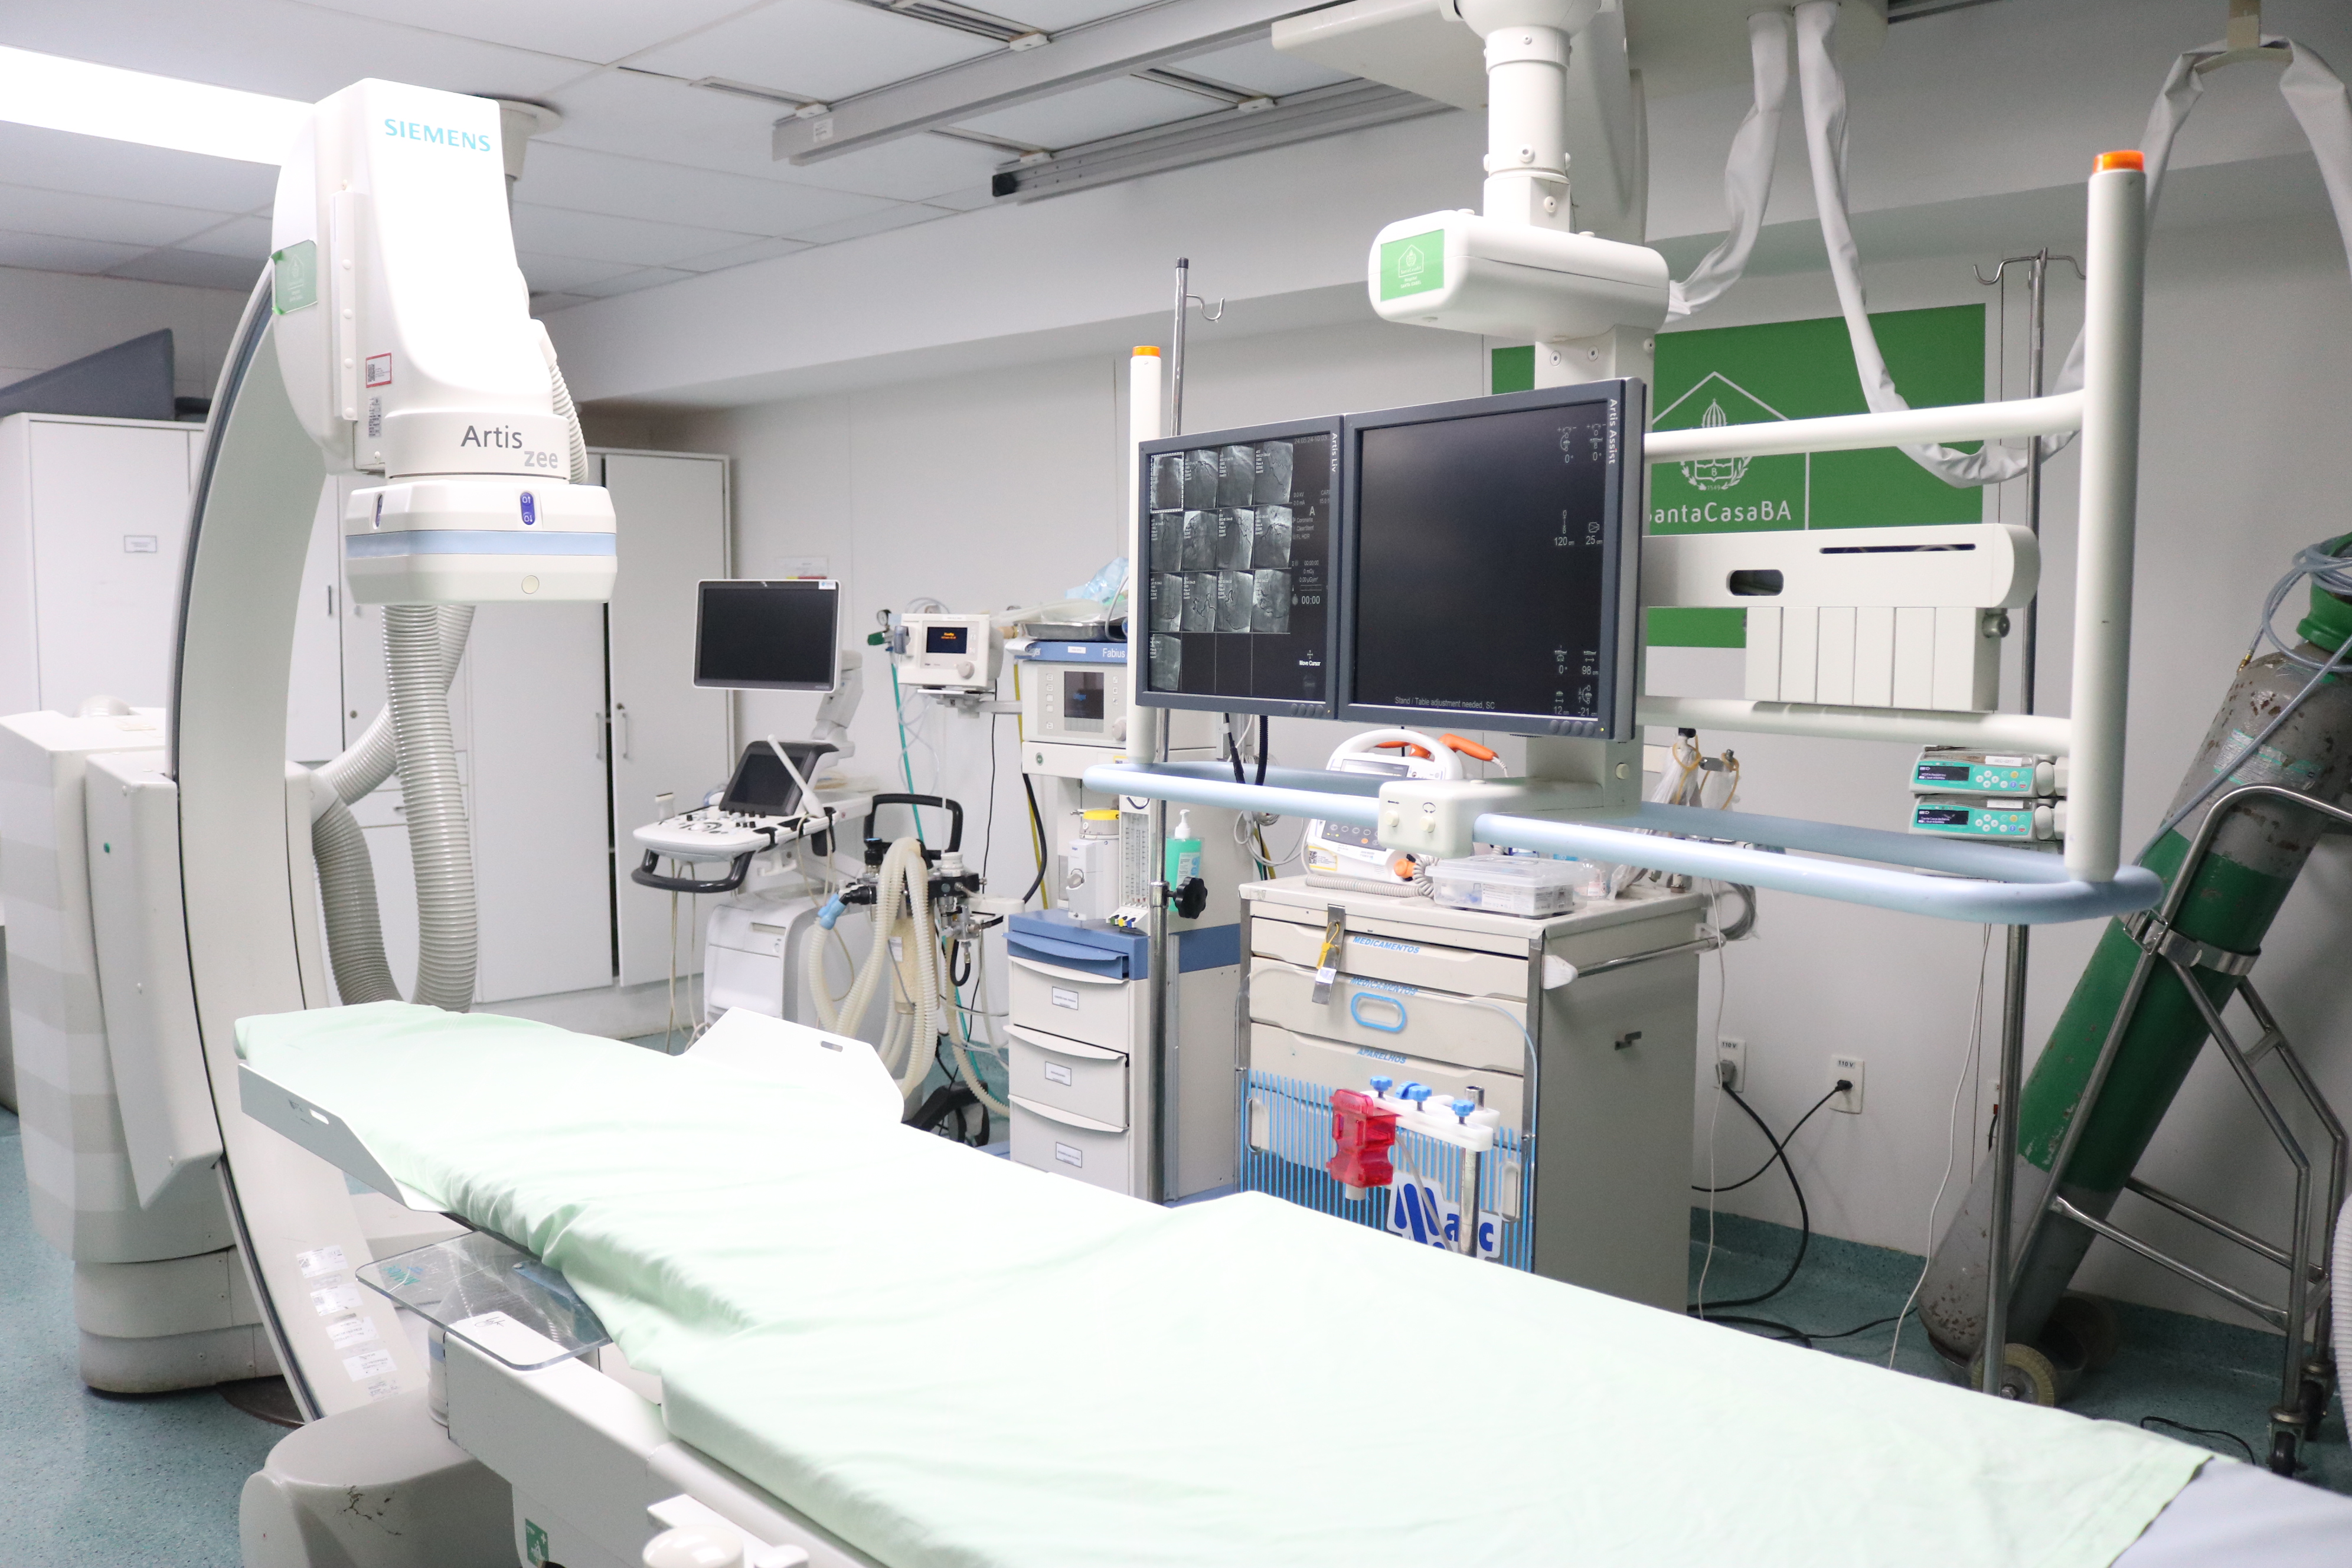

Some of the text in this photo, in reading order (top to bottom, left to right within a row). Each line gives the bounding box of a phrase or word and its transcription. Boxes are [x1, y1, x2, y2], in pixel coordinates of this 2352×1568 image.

[384, 119, 491, 152] SIEMENS
[460, 425, 558, 469] Artis zee
[1609, 430, 1618, 464] Assist
[1711, 468, 1717, 476] B
[1309, 506, 1315, 516] A
[1649, 501, 1791, 524] antaCasaBA
[1554, 536, 1567, 546] 120
[1586, 535, 1595, 545] 25
[1302, 596, 1320, 605] 00:00
[1103, 648, 1125, 658] Fabius
[1582, 666, 1592, 675] 98
[1415, 697, 1429, 705] Table
[1431, 698, 1461, 708] adjustment
[1462, 701, 1484, 710] needed,
[1486, 701, 1495, 710] SC
[1554, 705, 1563, 715] 12
[1353, 936, 1420, 953] MEDICAMENTOS
[1350, 978, 1418, 996] MEDICAMENTOS
[1357, 1048, 1407, 1064] APARELHOS
